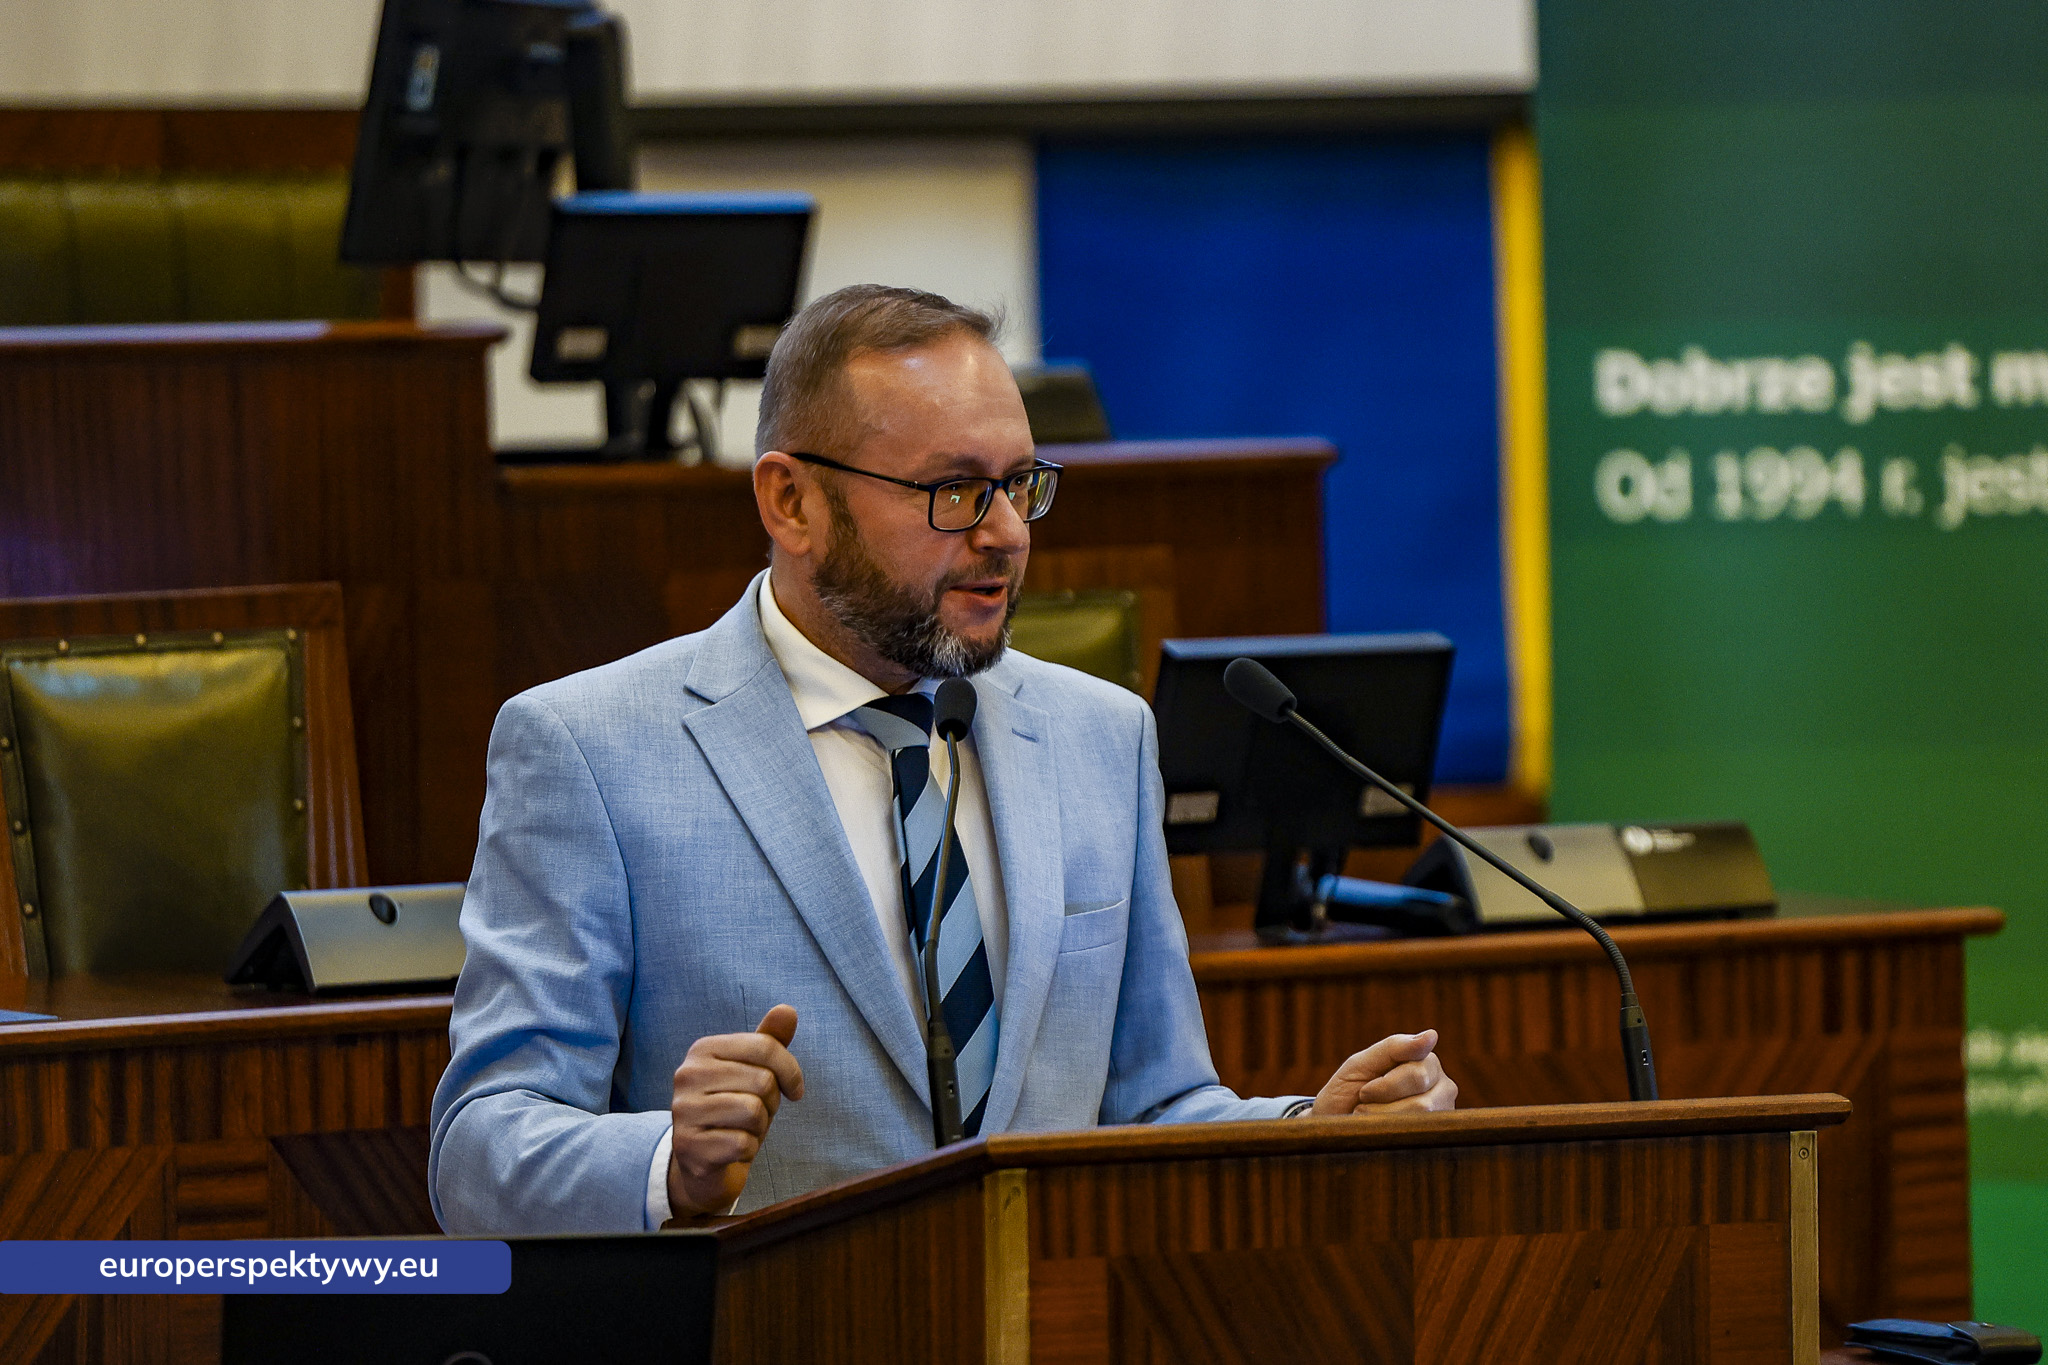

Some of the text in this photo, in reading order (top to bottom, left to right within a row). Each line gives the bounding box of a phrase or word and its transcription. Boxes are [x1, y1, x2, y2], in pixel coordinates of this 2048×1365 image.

[1593, 345, 1835, 416] Dobrze
[1842, 341, 1979, 424] jest
[1596, 447, 1692, 523] Od
[1713, 446, 1866, 520] 1994
